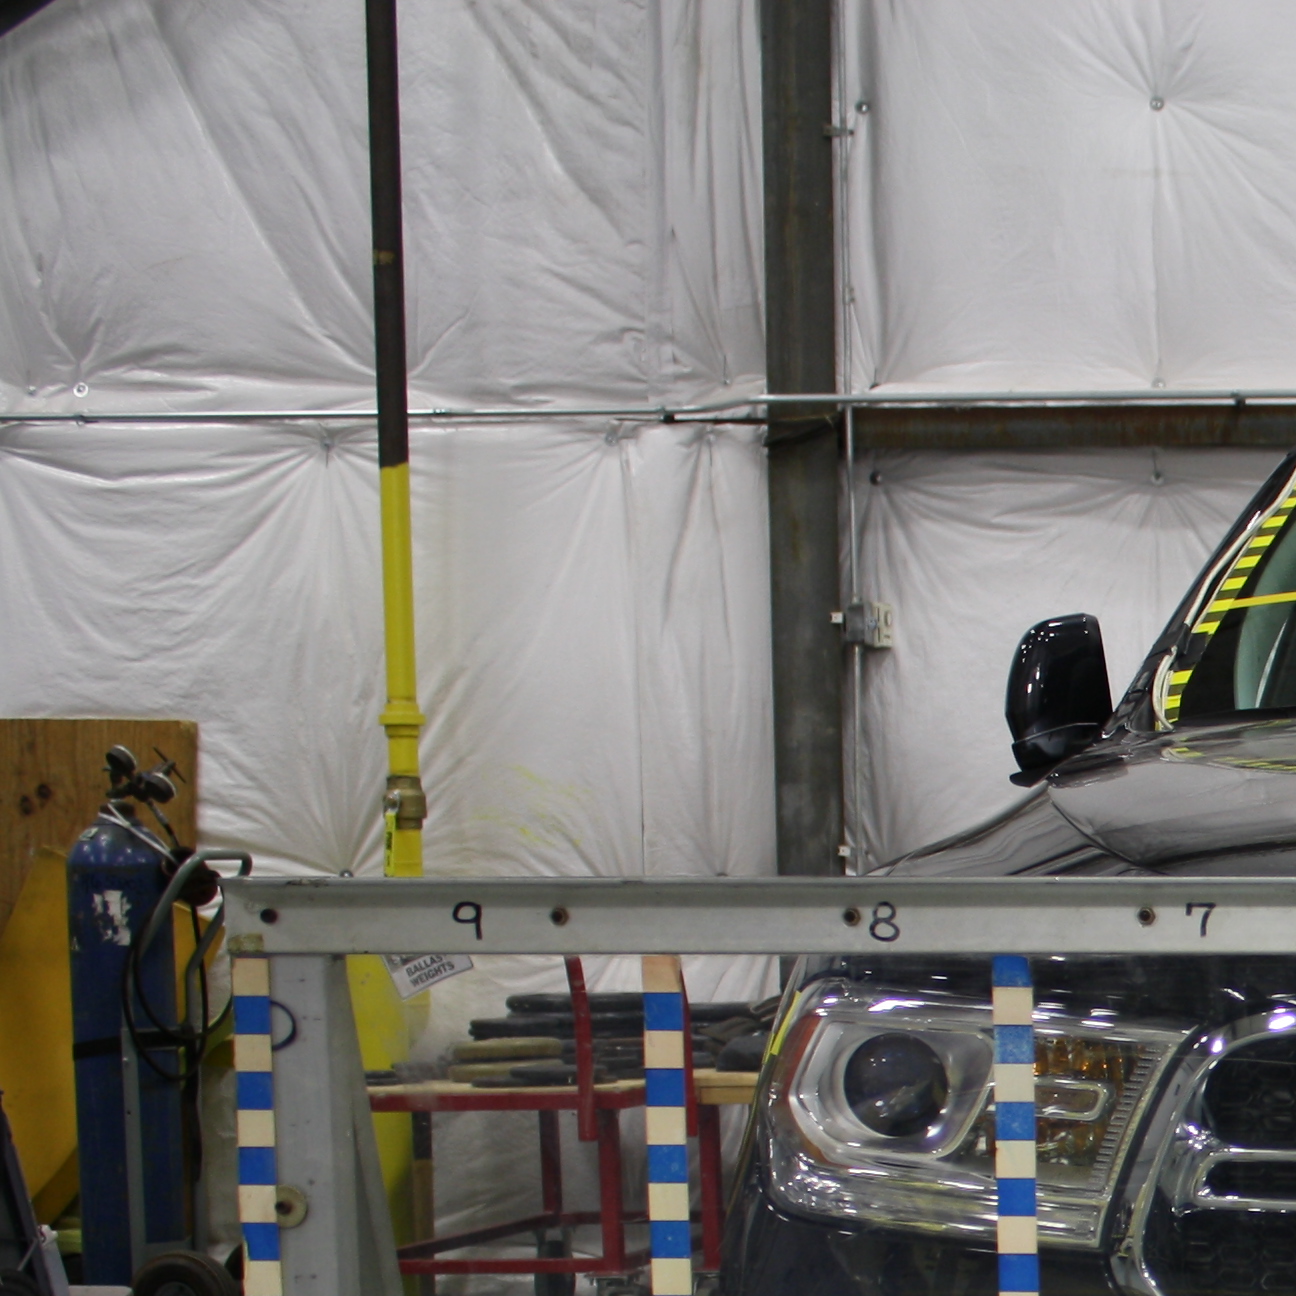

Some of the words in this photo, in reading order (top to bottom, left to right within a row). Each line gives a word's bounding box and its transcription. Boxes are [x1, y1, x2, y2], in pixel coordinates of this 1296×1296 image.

[451, 899, 483, 940] 9
[869, 900, 901, 942] 8
[1185, 901, 1218, 938] 7
[404, 954, 448, 977] BALLAS
[409, 960, 456, 987] WEIGHTS
